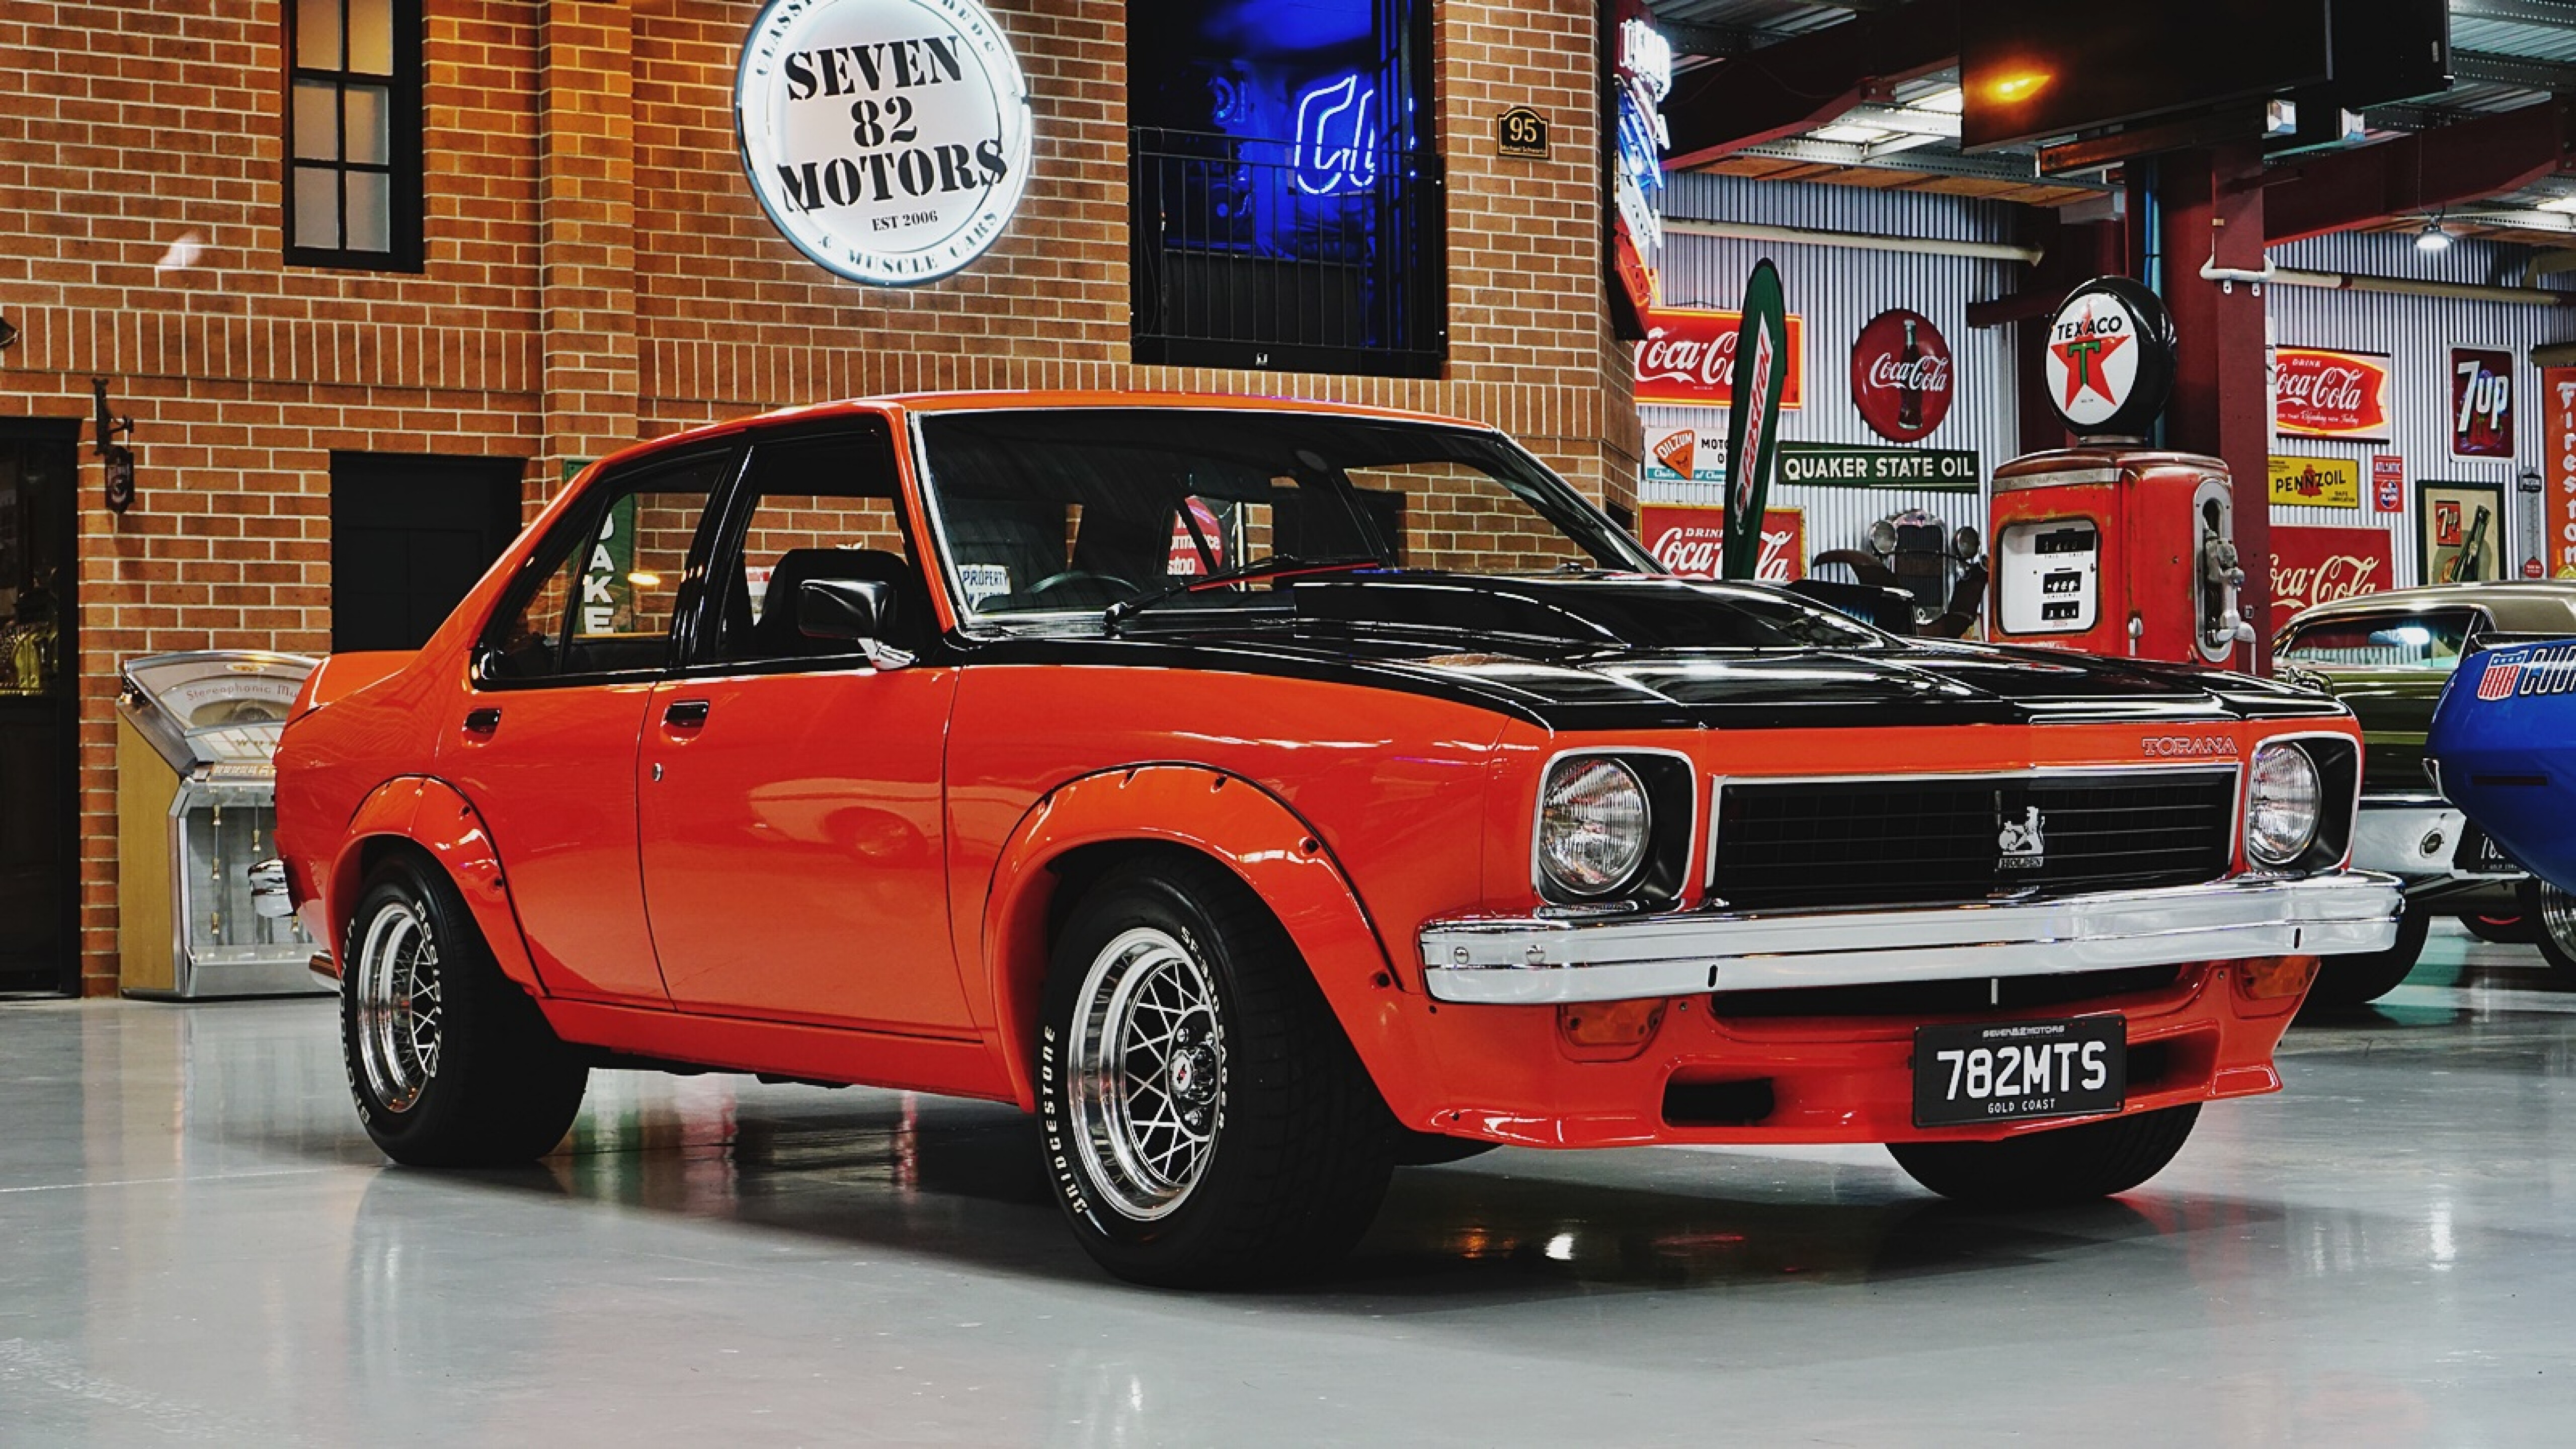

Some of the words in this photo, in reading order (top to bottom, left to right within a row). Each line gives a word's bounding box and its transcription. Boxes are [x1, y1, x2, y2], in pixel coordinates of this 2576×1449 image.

[784, 35, 962, 101] SEVEN
[851, 96, 917, 147] 82
[1509, 117, 1537, 142] 95
[777, 138, 1008, 214] MOTORS
[871, 215, 899, 232] EST
[902, 209, 939, 227] 2006
[849, 249, 938, 274] MUSCLE
[949, 209, 997, 258] CARS
[2057, 315, 2123, 340] TEXACO
[2067, 339, 2102, 386] T
[1656, 433, 1693, 459] OILZUM
[1785, 458, 1868, 480] QUAKER
[1875, 457, 1934, 477] STATE
[1941, 457, 1974, 477] OIL
[2276, 469, 2347, 494] PENNZOIL
[186, 682, 272, 701] Stereophonic
[2142, 736, 2238, 756] TORANA
[1936, 1040, 2107, 1100] 782MTS
[1987, 1101, 2015, 1114] GOLD
[2022, 1097, 2056, 1111] COAST
[1042, 1024, 1088, 1214] BRIDGESTONE
